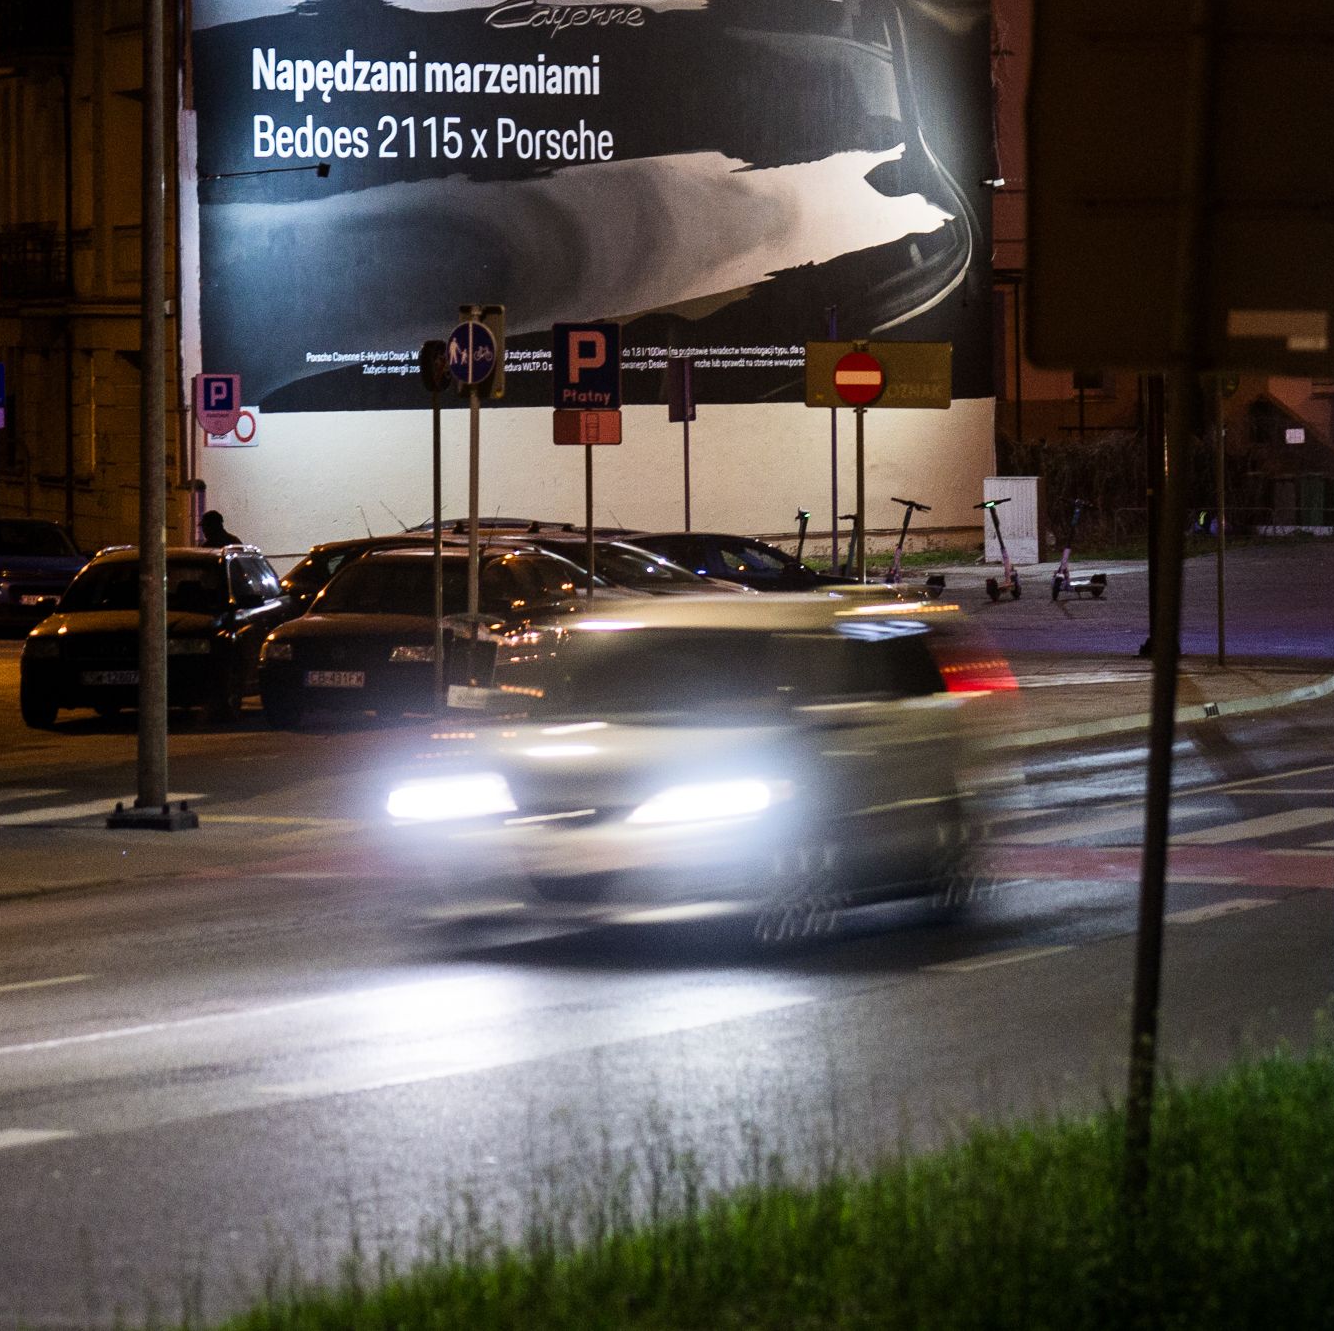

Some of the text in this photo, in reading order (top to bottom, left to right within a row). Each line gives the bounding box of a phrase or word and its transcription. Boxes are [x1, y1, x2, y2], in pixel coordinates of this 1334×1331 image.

[252, 48, 600, 103] Napędzani marzeniami
[253, 114, 614, 161] Bedoes 2115 x Porsche
[306, 352, 332, 362] Porsche
[333, 352, 360, 363] Cayenne
[361, 351, 388, 363] E-Hybrid
[532, 349, 552, 360] paliwa
[569, 331, 606, 384] P
[388, 364, 409, 376] energii
[210, 381, 227, 407] P
[563, 389, 612, 405] Płatny
